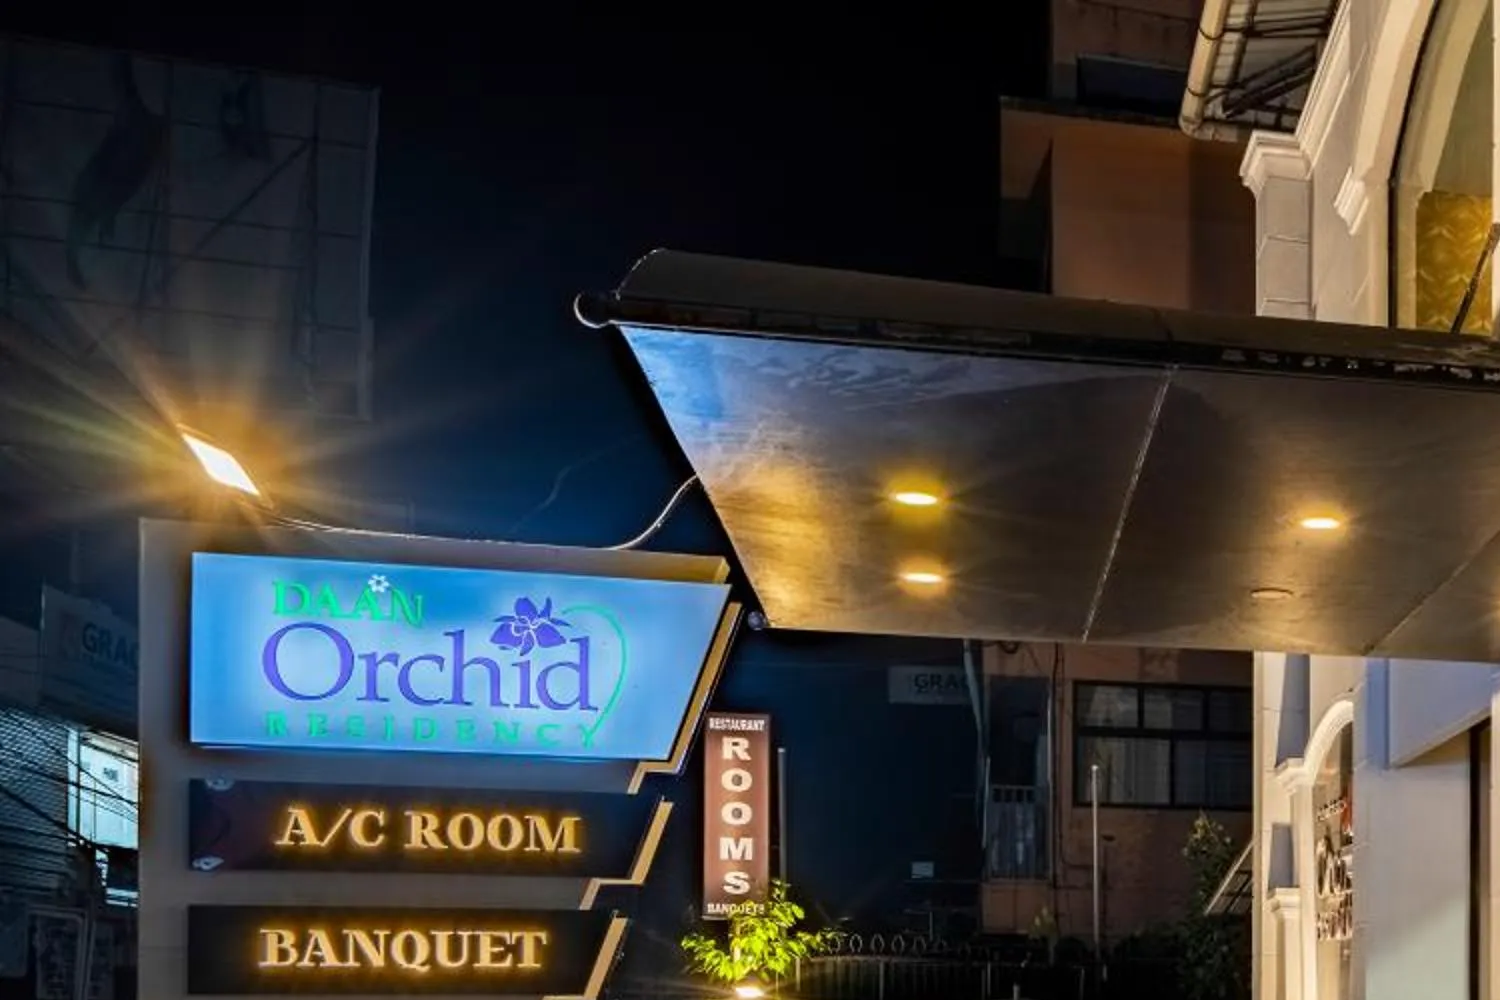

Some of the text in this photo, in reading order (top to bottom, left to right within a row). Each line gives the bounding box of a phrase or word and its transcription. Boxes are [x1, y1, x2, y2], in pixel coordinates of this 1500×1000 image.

[272, 578, 424, 628] DAAN
[262, 621, 599, 712] Orchid
[264, 709, 604, 749] RESIDENCY
[709, 717, 765, 731] RESTAURANT
[275, 806, 582, 853] A/C ROOM
[720, 736, 753, 895] ROOMS
[259, 929, 547, 972] BANQUET
